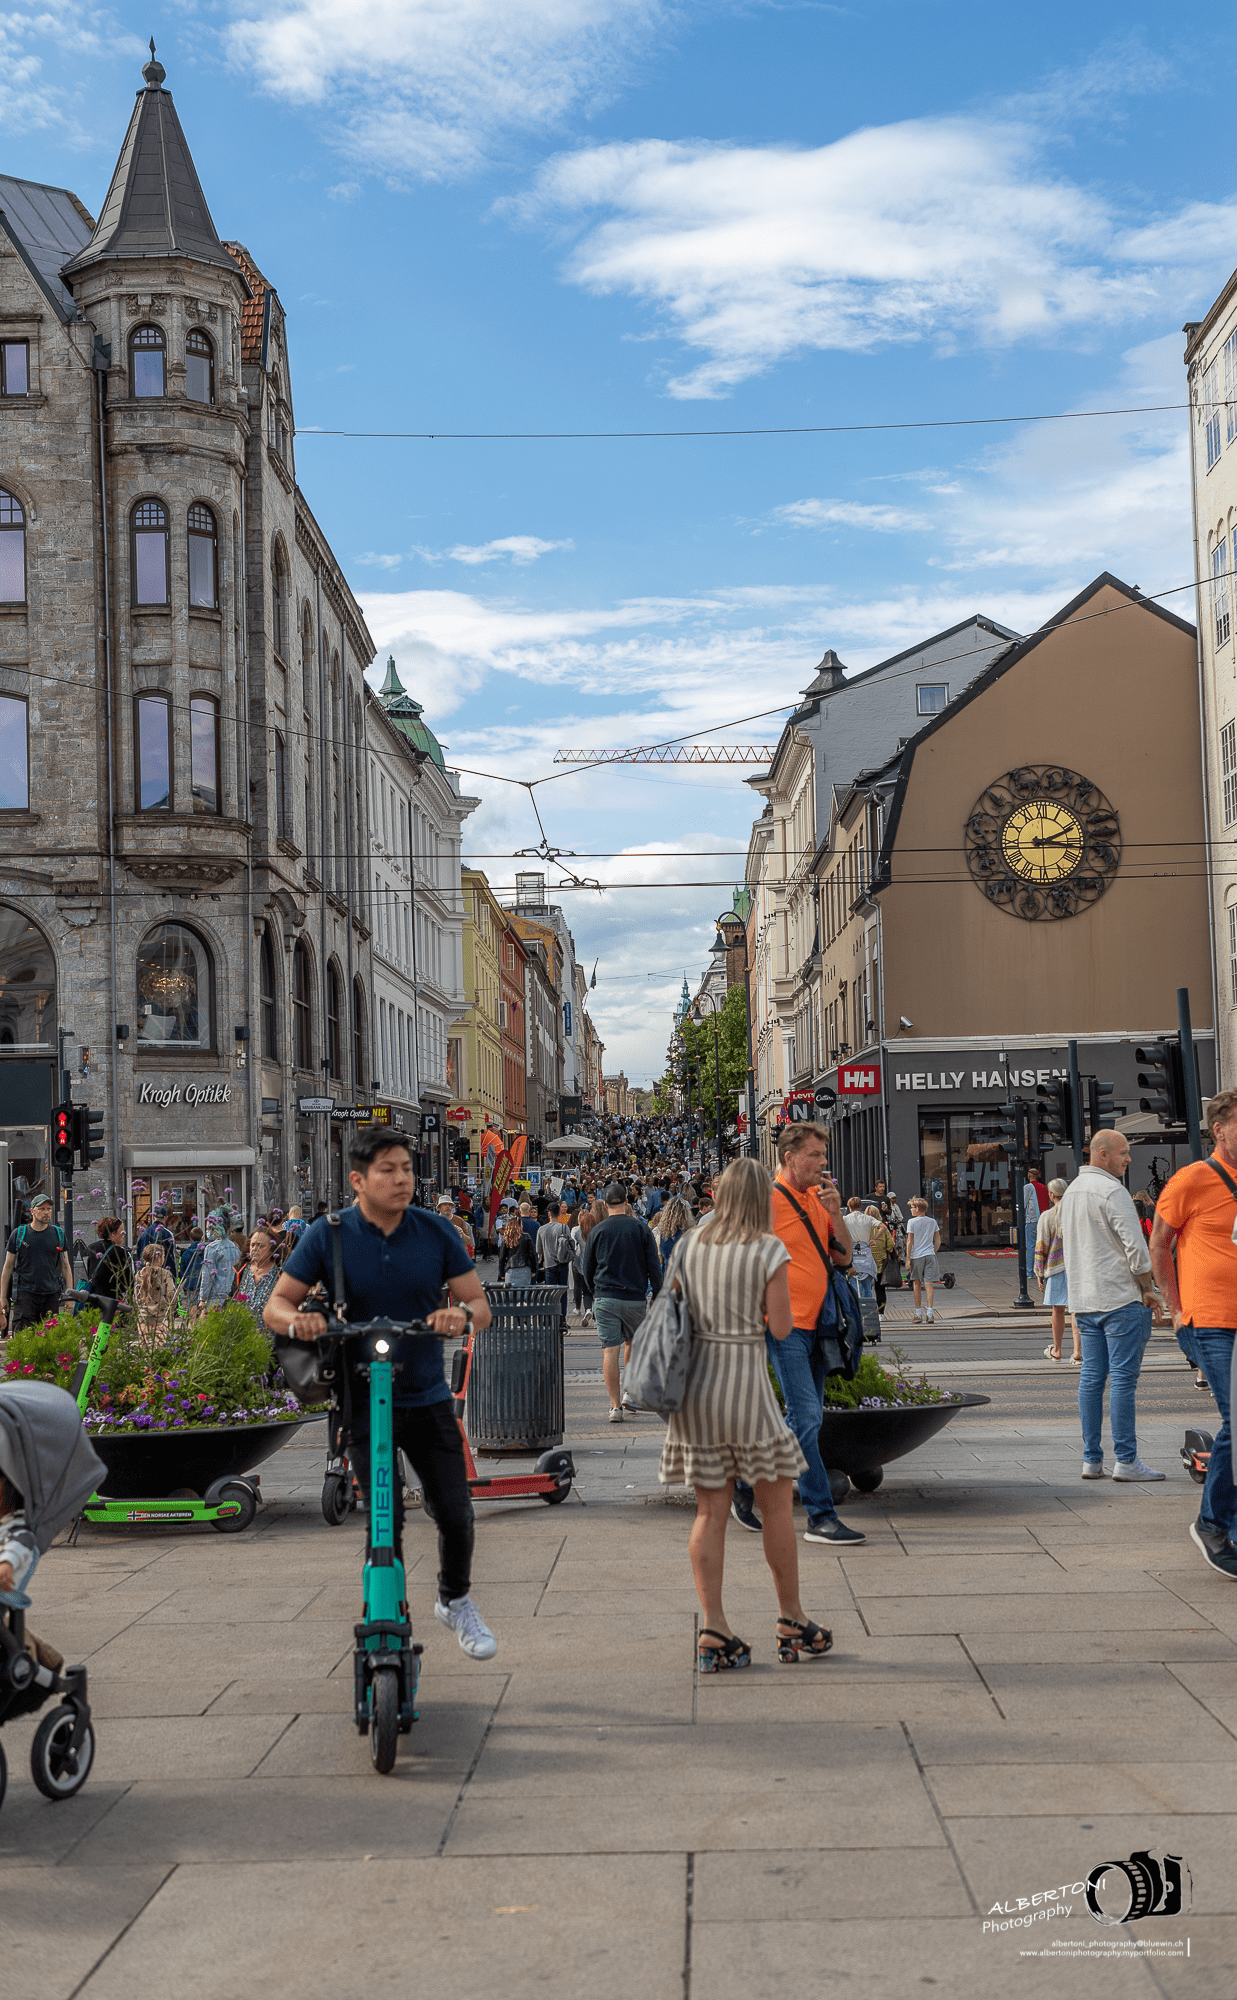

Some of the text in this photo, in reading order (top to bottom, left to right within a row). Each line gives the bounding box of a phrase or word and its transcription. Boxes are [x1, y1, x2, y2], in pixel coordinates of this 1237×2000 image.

[844, 1071, 875, 1088] HH
[895, 1069, 1067, 1090] HELLY HANSEN
[140, 1083, 231, 1107] Krogh Optikk
[350, 1109, 370, 1118] Optikk
[792, 1103, 808, 1121] N
[957, 1162, 1008, 1190] HH
[377, 1468, 390, 1541] TIER
